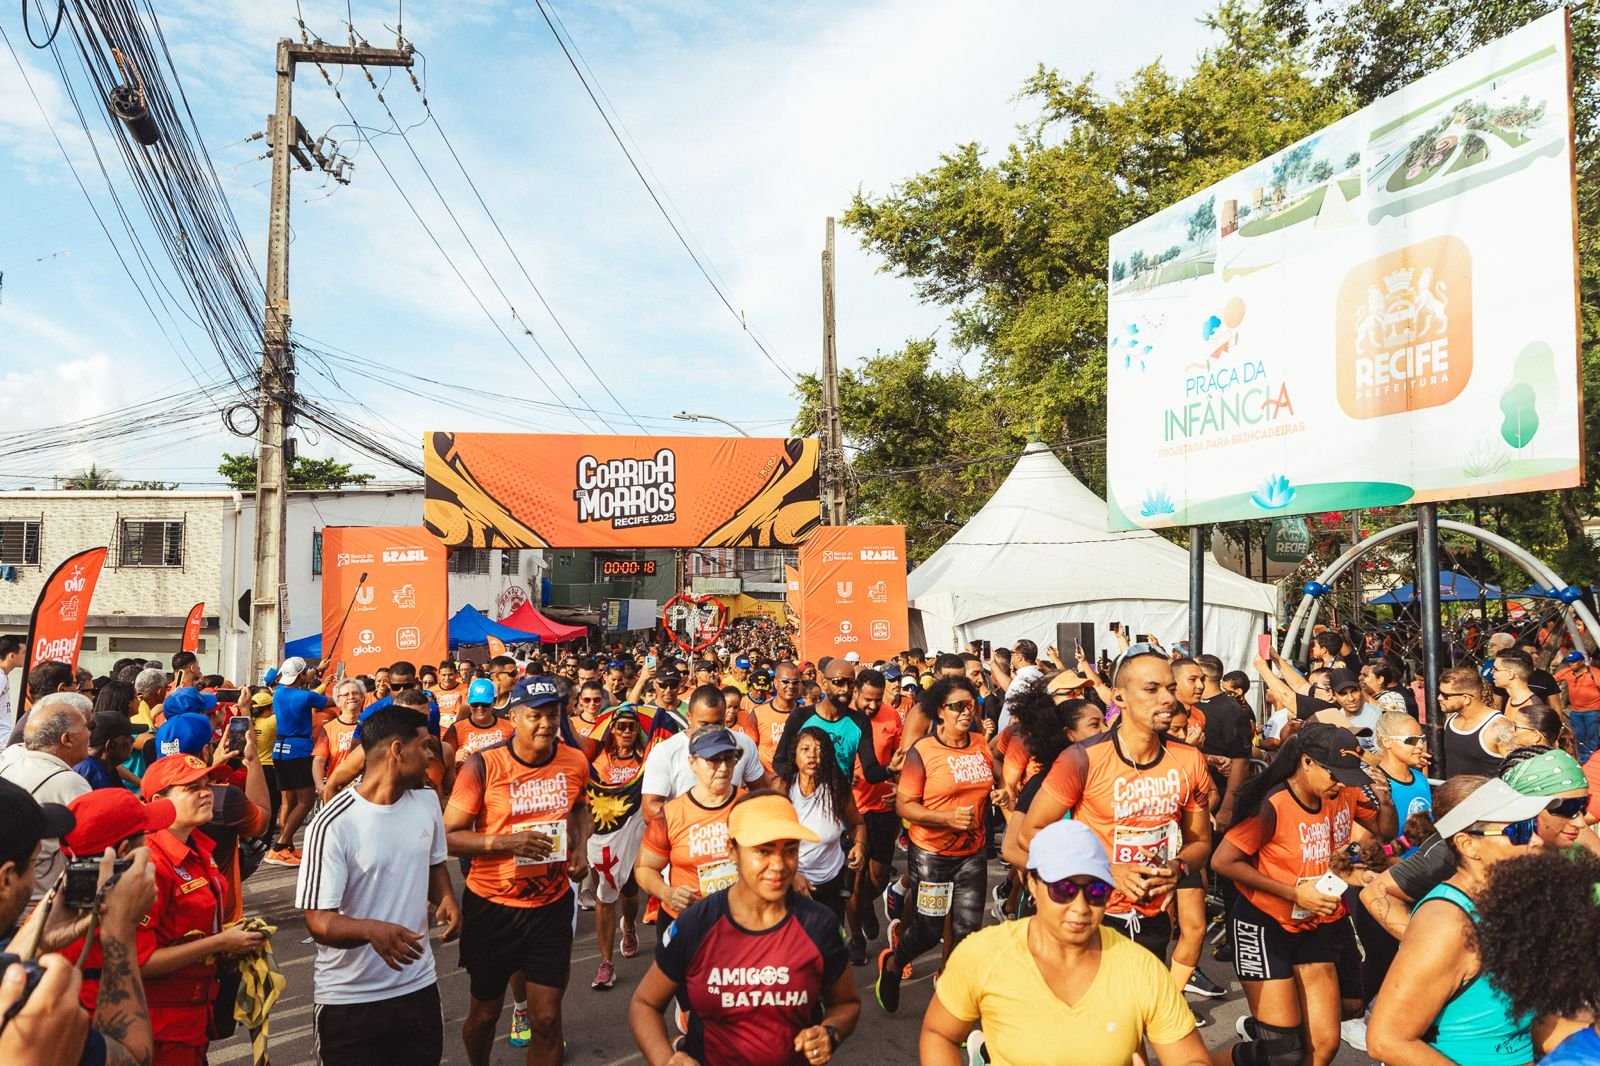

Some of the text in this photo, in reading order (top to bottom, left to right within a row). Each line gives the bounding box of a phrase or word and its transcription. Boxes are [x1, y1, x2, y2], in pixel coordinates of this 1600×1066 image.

[1356, 338, 1448, 389] RECIFE
[1186, 360, 1267, 398] PRAÇA DA
[1356, 374, 1448, 400] PREFEITURA
[1165, 381, 1294, 442] INFÂNCIA
[1206, 437, 1230, 450] PARA
[1231, 421, 1306, 445] BRINCADEIRAS
[579, 449, 675, 490] CORRIDA
[580, 482, 675, 521] MORROS
[614, 513, 676, 527] RECIFE 2025
[382, 550, 428, 563] BRASIL
[860, 550, 898, 561] BRASIL
[1275, 542, 1307, 553] RECIFE
[352, 644, 382, 657] globo
[834, 634, 859, 645] globo
[509, 771, 568, 799] CORRIDA
[1113, 768, 1180, 802] CORRIDA
[511, 790, 569, 817] MORROS
[1114, 793, 1180, 822] MORROS
[1237, 920, 1264, 979] EXTREME
[707, 965, 790, 986] AMIGOS
[721, 990, 808, 1008] BATALHA
